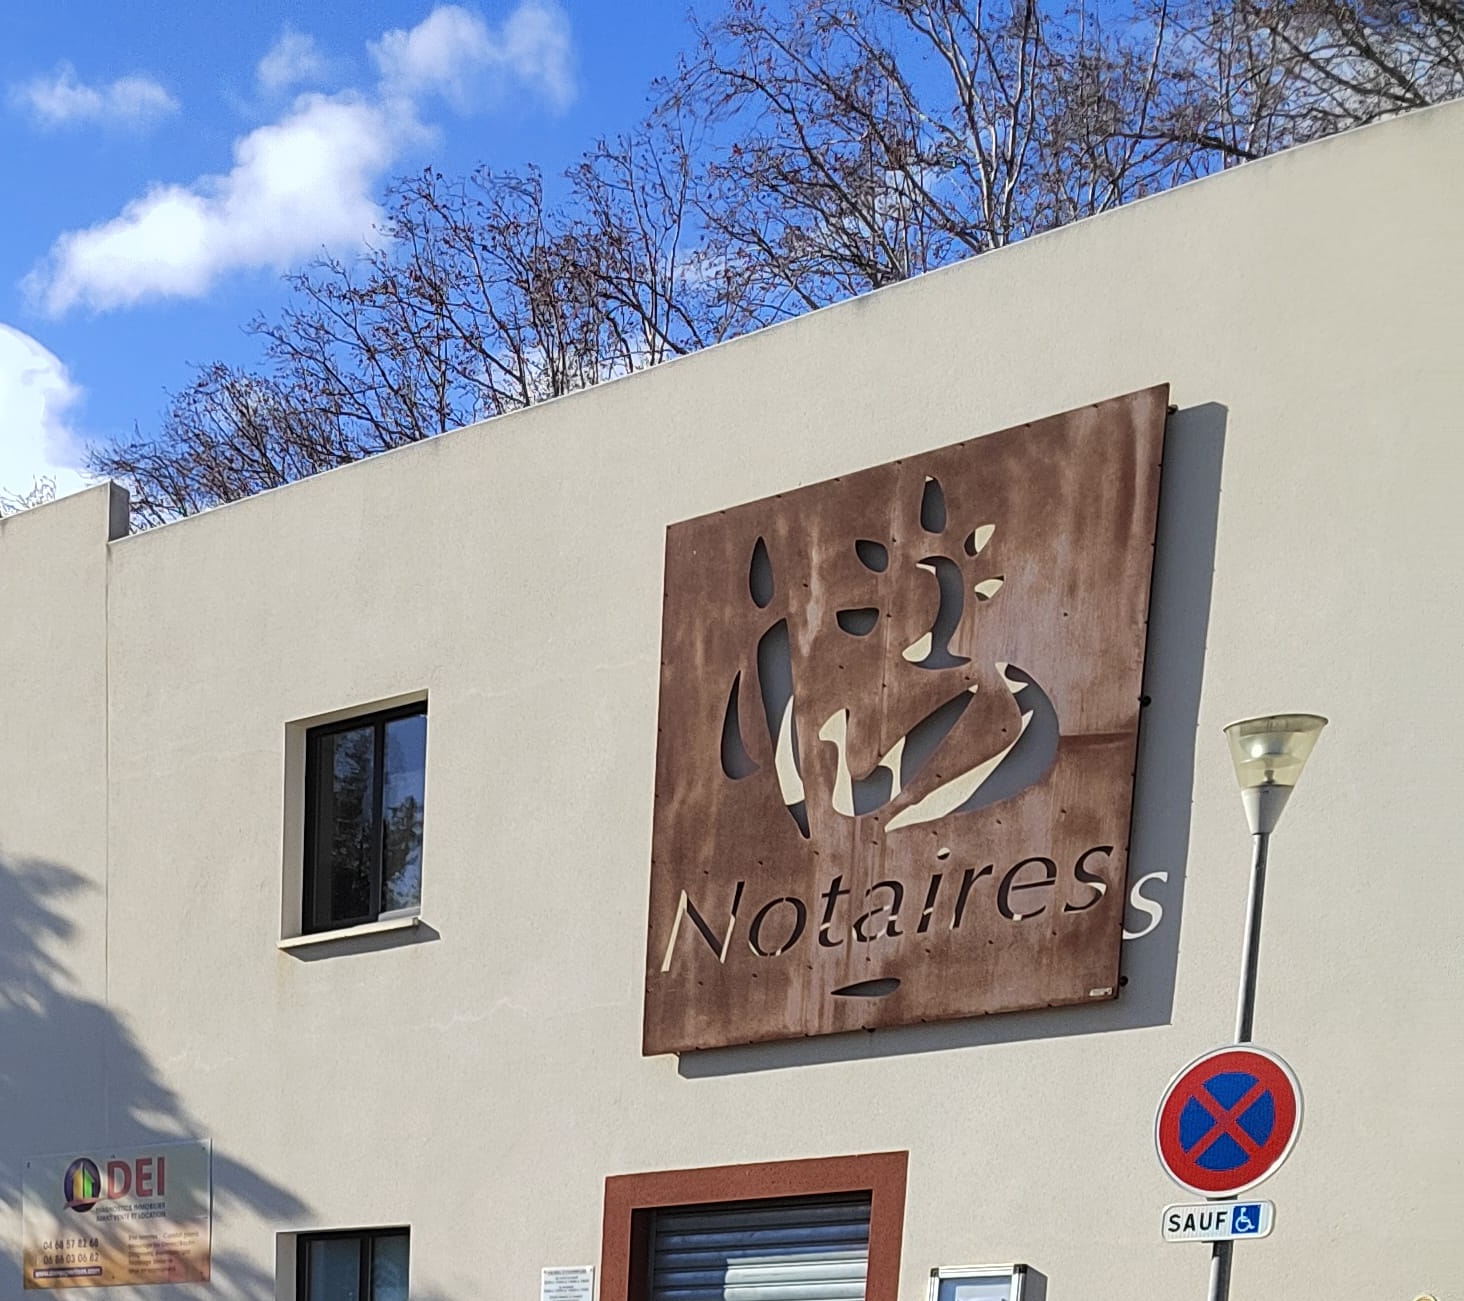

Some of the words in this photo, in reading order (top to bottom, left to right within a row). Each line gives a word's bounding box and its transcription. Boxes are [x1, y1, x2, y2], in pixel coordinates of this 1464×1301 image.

[660, 844, 1115, 974] Notaires
[106, 1156, 165, 1200] DEI
[1167, 1211, 1228, 1233] SAUF
